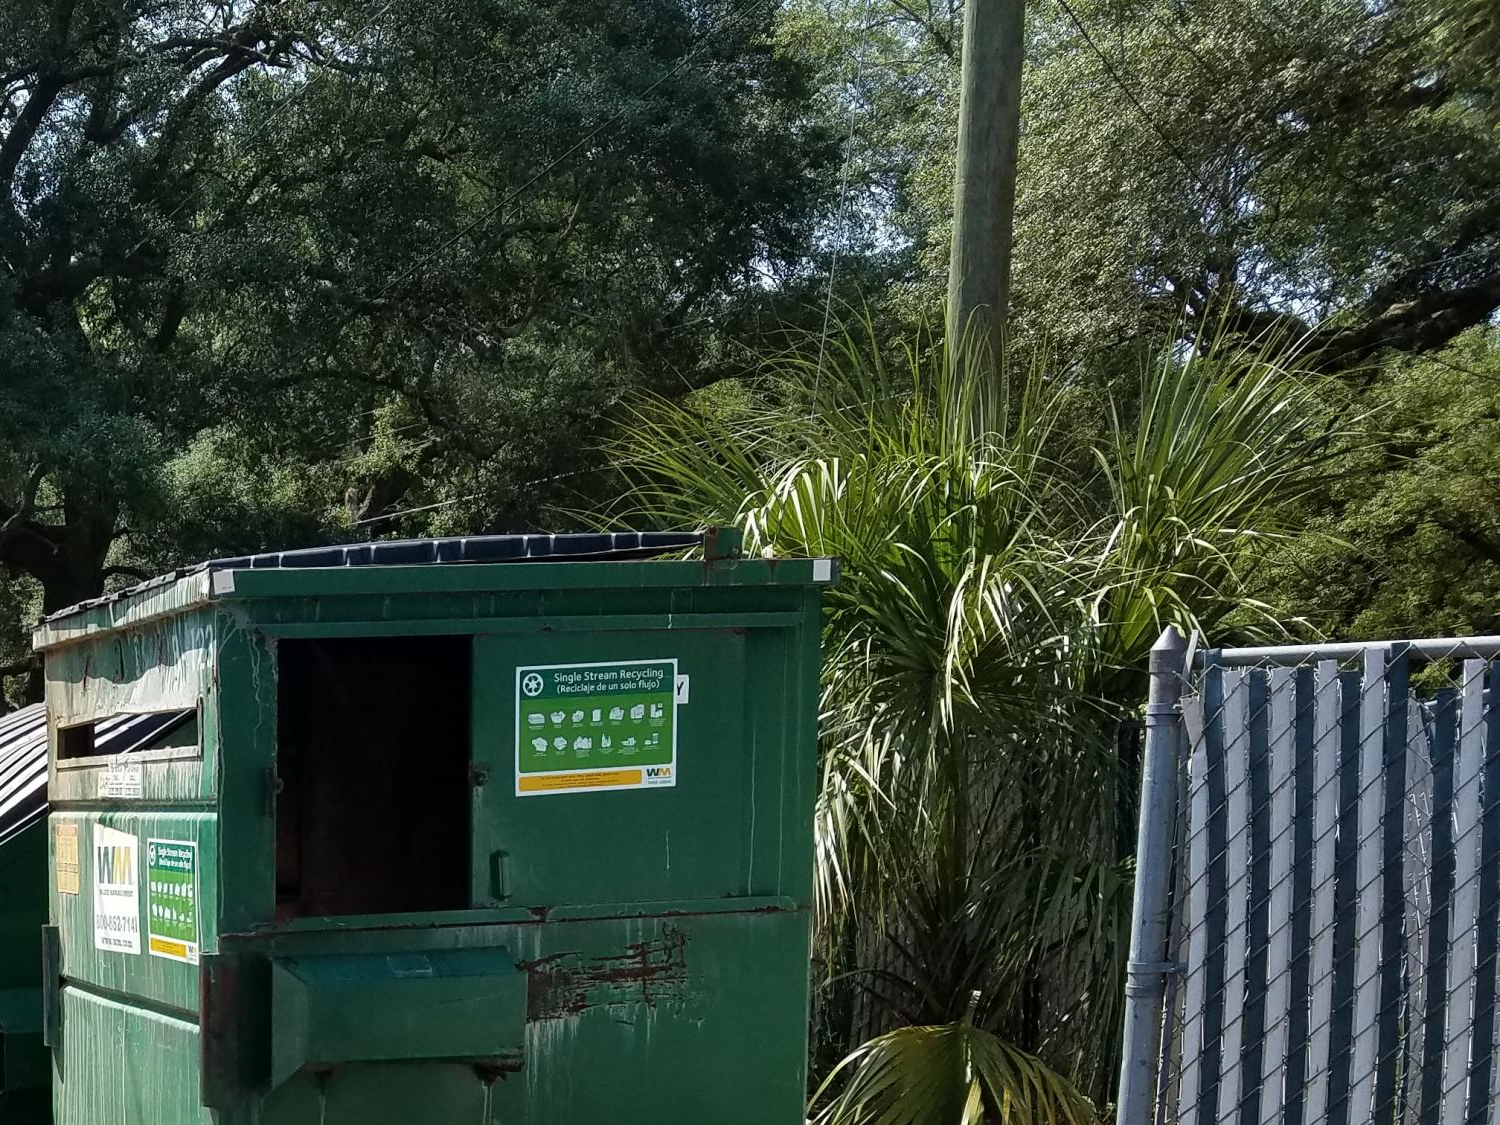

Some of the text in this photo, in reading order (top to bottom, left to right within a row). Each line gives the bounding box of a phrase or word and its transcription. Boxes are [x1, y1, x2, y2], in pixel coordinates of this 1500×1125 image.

[554, 668, 664, 684] Single Stream Recycling
[556, 683, 595, 694] (Reciclaje
[596, 682, 606, 691] de
[620, 681, 636, 690] solo
[638, 679, 660, 690] flujo)
[646, 768, 671, 776] WM
[98, 846, 132, 884] WM
